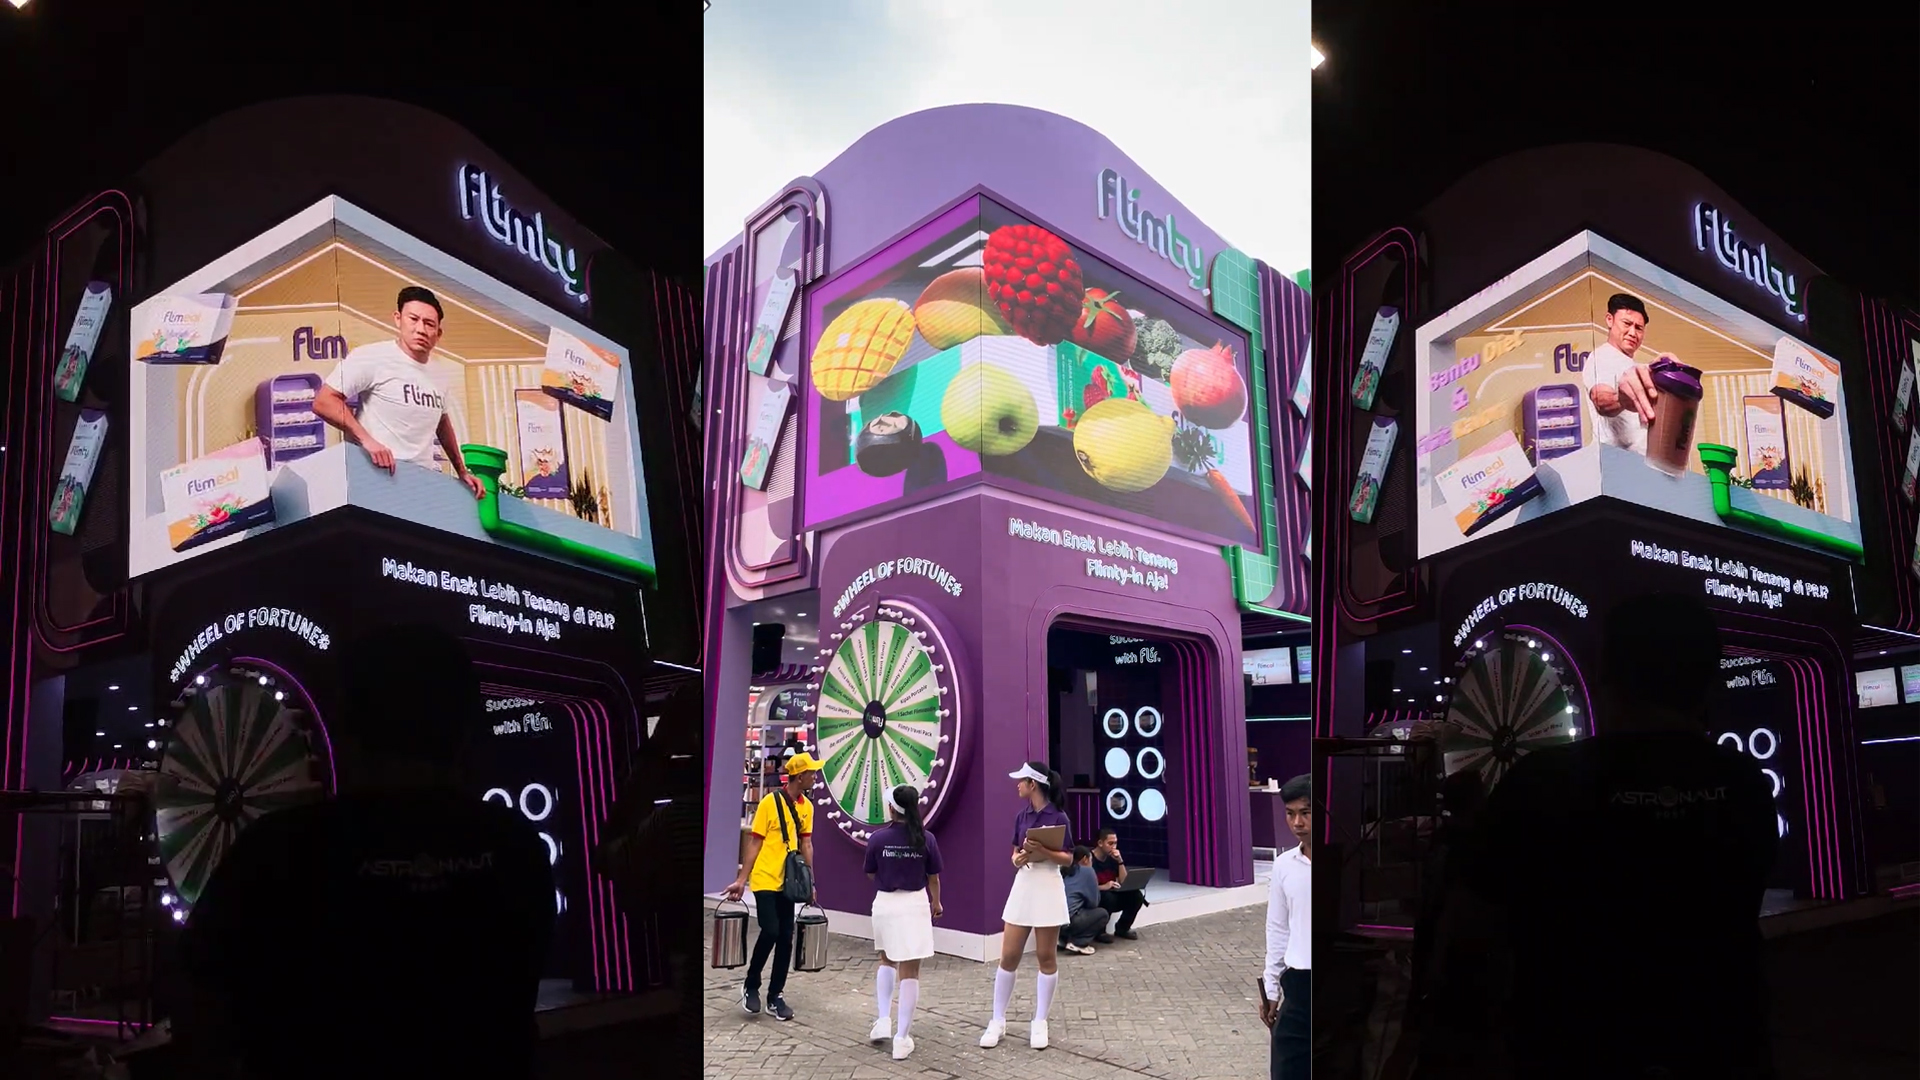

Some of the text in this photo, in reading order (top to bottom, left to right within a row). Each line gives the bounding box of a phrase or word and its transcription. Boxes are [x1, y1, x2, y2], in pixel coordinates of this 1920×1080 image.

[293, 326, 348, 361] Flim
[187, 466, 239, 496] Flimeal
[1461, 456, 1505, 489] Flimeal
[1008, 517, 1178, 575] Makan Enak Lebih Tenang
[877, 560, 895, 579] OF
[1086, 557, 1169, 592] Flimty-in Aja!
[1631, 539, 1678, 565] Makan
[1681, 551, 1713, 572] Enak
[1715, 557, 1749, 579] Lebih
[1750, 566, 1791, 593] Tenang
[1793, 579, 1804, 596] di
[382, 557, 438, 587] Makan
[441, 571, 478, 597] Enak
[480, 579, 521, 605] Lebih
[522, 590, 570, 622] Tenang
[573, 607, 586, 625] di
[1499, 587, 1517, 606] OF
[1705, 578, 1783, 609] Flimty-in Aja!
[224, 612, 245, 634] OF
[469, 603, 561, 641] Flimty-in Aja!
[1114, 651, 1138, 665] with
[1726, 675, 1750, 689] with
[493, 719, 521, 736] with
